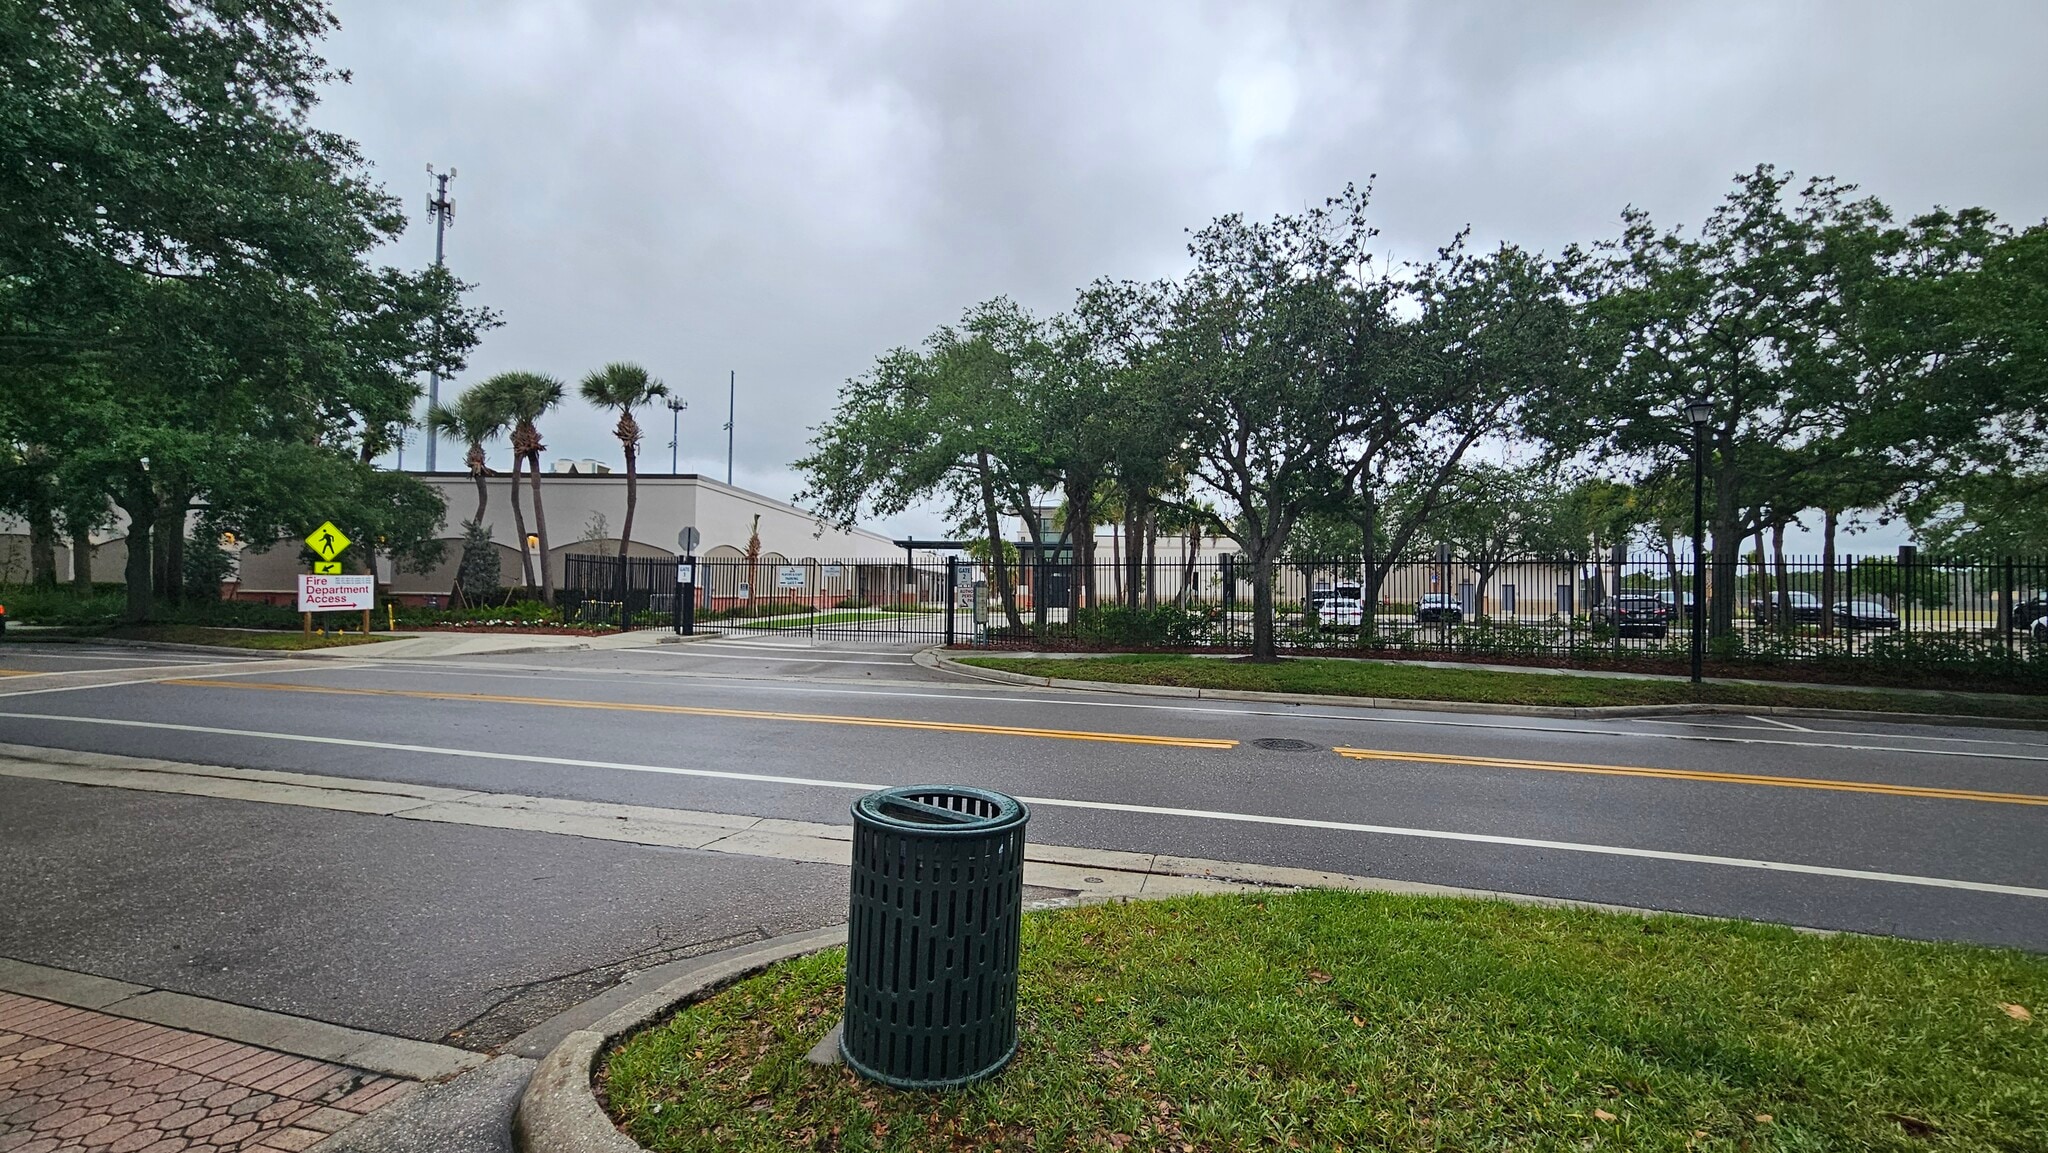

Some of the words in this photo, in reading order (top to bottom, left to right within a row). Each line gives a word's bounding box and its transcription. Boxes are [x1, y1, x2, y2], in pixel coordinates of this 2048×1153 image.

[306, 576, 327, 585] Fire
[306, 585, 369, 596] Department
[306, 595, 347, 603] Access
